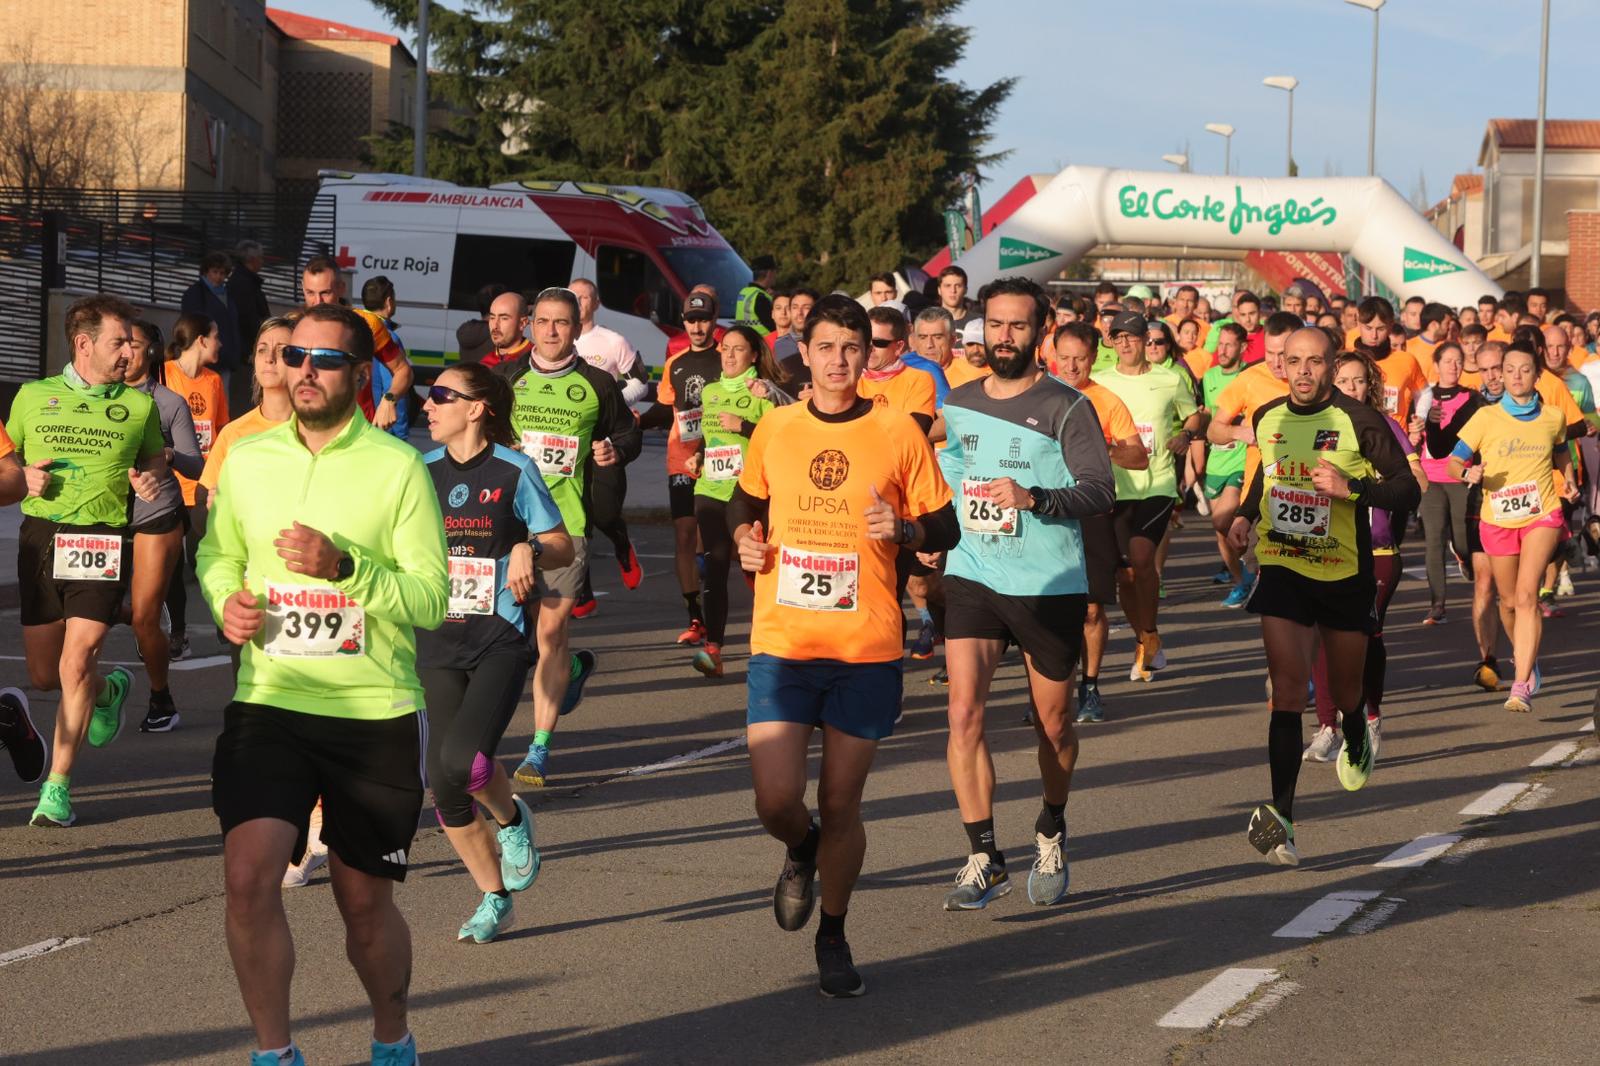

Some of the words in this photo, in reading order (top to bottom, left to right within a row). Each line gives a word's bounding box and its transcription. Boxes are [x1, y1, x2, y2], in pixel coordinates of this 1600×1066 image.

[428, 193, 524, 209] AMBULANCIA
[1119, 185, 1149, 218] El
[1152, 189, 1225, 223] Corte
[1229, 185, 1337, 236] Inglés
[362, 255, 399, 271] Cruz
[403, 257, 439, 275] Roja
[514, 404, 583, 419] ORRECAMINOS
[516, 414, 571, 427] CARBAJOSA
[35, 424, 126, 441] CORRECAMINOS
[44, 434, 112, 449] CARBAJOSA
[52, 446, 102, 456] SALAMANCA
[711, 457, 734, 473] 104
[999, 459, 1031, 470] SEGOVIA
[798, 495, 850, 516] UPSA
[1271, 486, 1330, 507] bedunia
[1501, 495, 1531, 513] 284
[969, 500, 1003, 521] 263
[1277, 503, 1316, 525] 285
[444, 514, 494, 529] Botanik
[56, 536, 120, 550] bedunia
[68, 550, 107, 569] 208
[782, 549, 856, 573] bedunia
[800, 573, 832, 597] 25
[285, 611, 343, 640] 399
